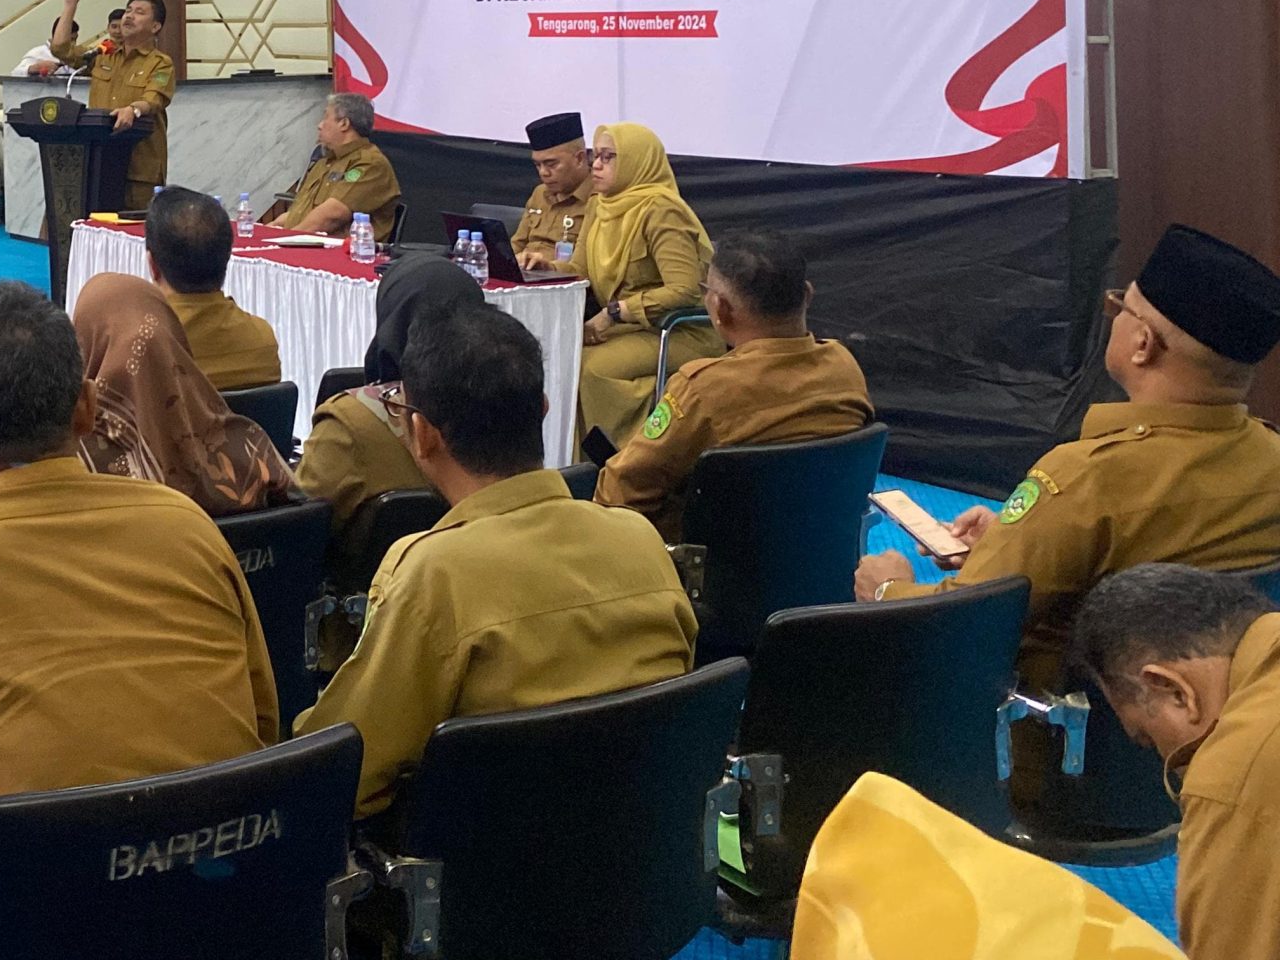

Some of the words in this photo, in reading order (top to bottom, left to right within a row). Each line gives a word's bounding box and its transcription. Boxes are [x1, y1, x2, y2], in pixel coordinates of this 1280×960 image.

[536, 16, 600, 34] Tenggarong,
[602, 15, 616, 30] 25
[618, 15, 675, 31] November
[677, 14, 707, 30] 2024
[108, 808, 282, 881] BAPPEDA
